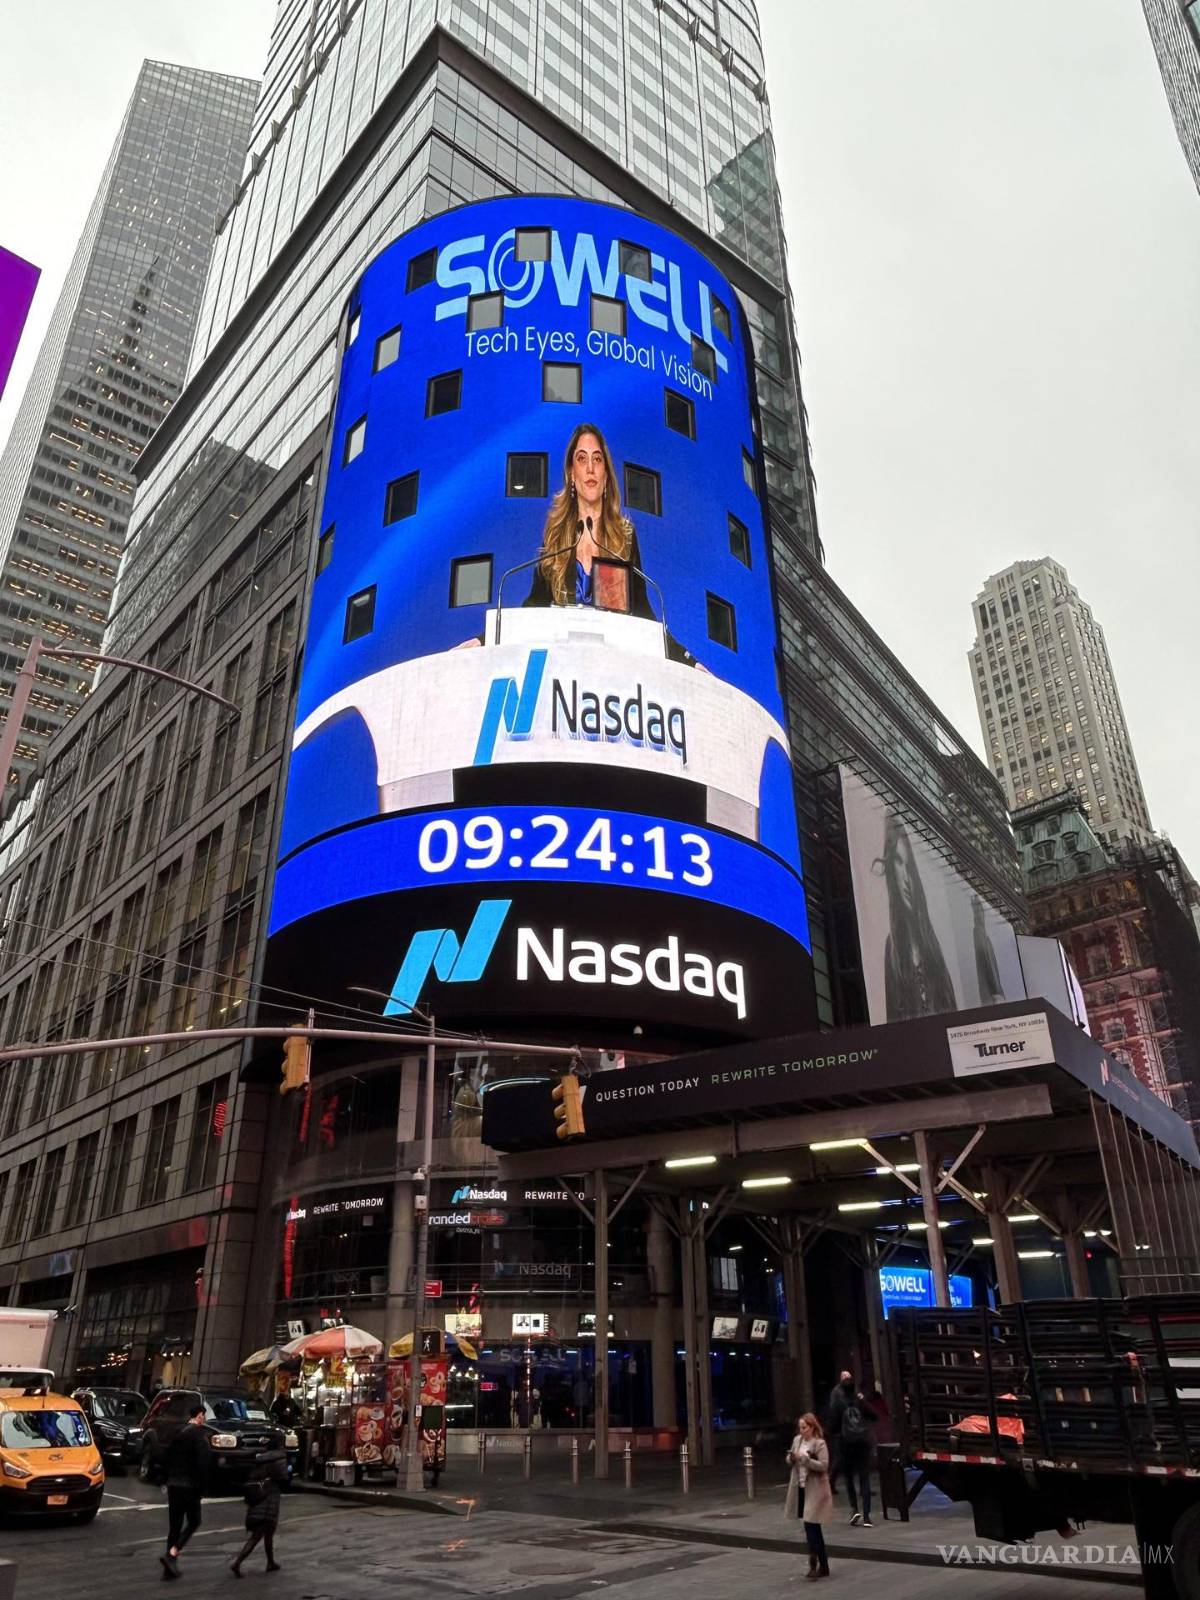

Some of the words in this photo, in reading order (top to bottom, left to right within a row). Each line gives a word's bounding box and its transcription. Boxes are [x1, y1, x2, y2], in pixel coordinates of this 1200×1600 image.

[435, 226, 729, 373] SOWELL
[465, 331, 518, 358] Tech
[525, 326, 580, 360] Eyes,
[586, 330, 656, 371] Global
[661, 350, 713, 401] Vision
[551, 678, 688, 766] Nasdaq
[418, 814, 714, 887] 09:24:13
[516, 927, 747, 1020] Nasdaq
[595, 1084, 655, 1103] QUESTION
[660, 1076, 700, 1093] TODAY
[711, 1064, 776, 1085] REWRITE
[973, 1040, 1026, 1058] Turner
[469, 1188, 507, 1201] Nasdaq
[524, 1190, 568, 1200] REWRITE
[519, 1262, 572, 1279] Nasdaq
